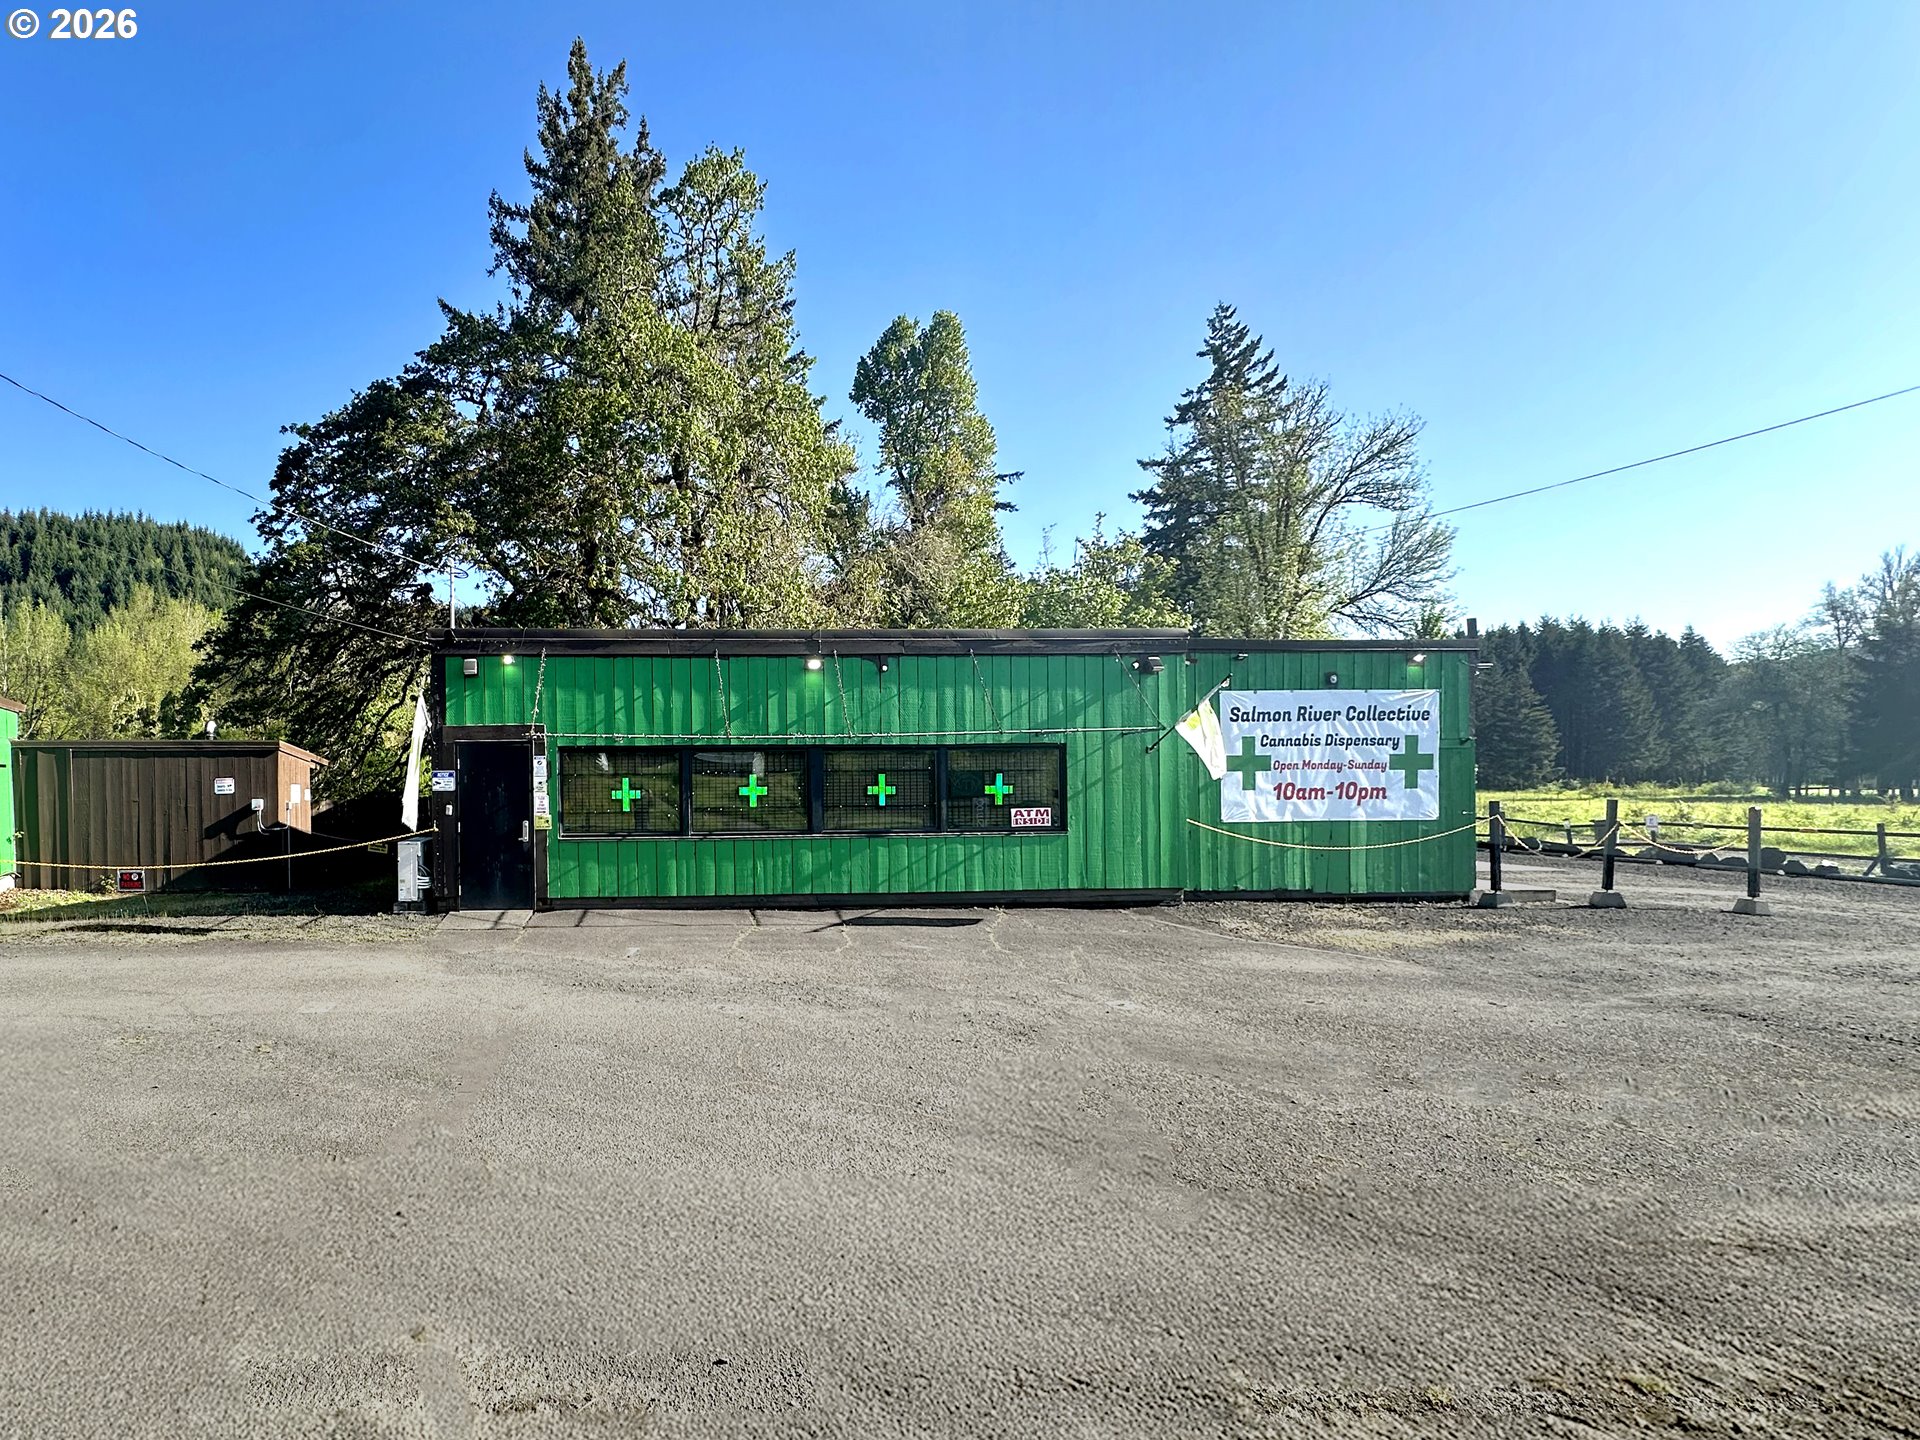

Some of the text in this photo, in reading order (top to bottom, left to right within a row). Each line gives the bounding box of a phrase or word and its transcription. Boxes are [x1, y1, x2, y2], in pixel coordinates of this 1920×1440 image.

[1229, 704, 1431, 723] Salmon River Collective
[1260, 733, 1400, 751] Cannabis Dispensary
[1273, 759, 1388, 773] Open Monday-Sunday
[1273, 781, 1388, 806] 10am-10pm
[1013, 809, 1050, 818] ATM
[1013, 817, 1050, 825] INSIDE
